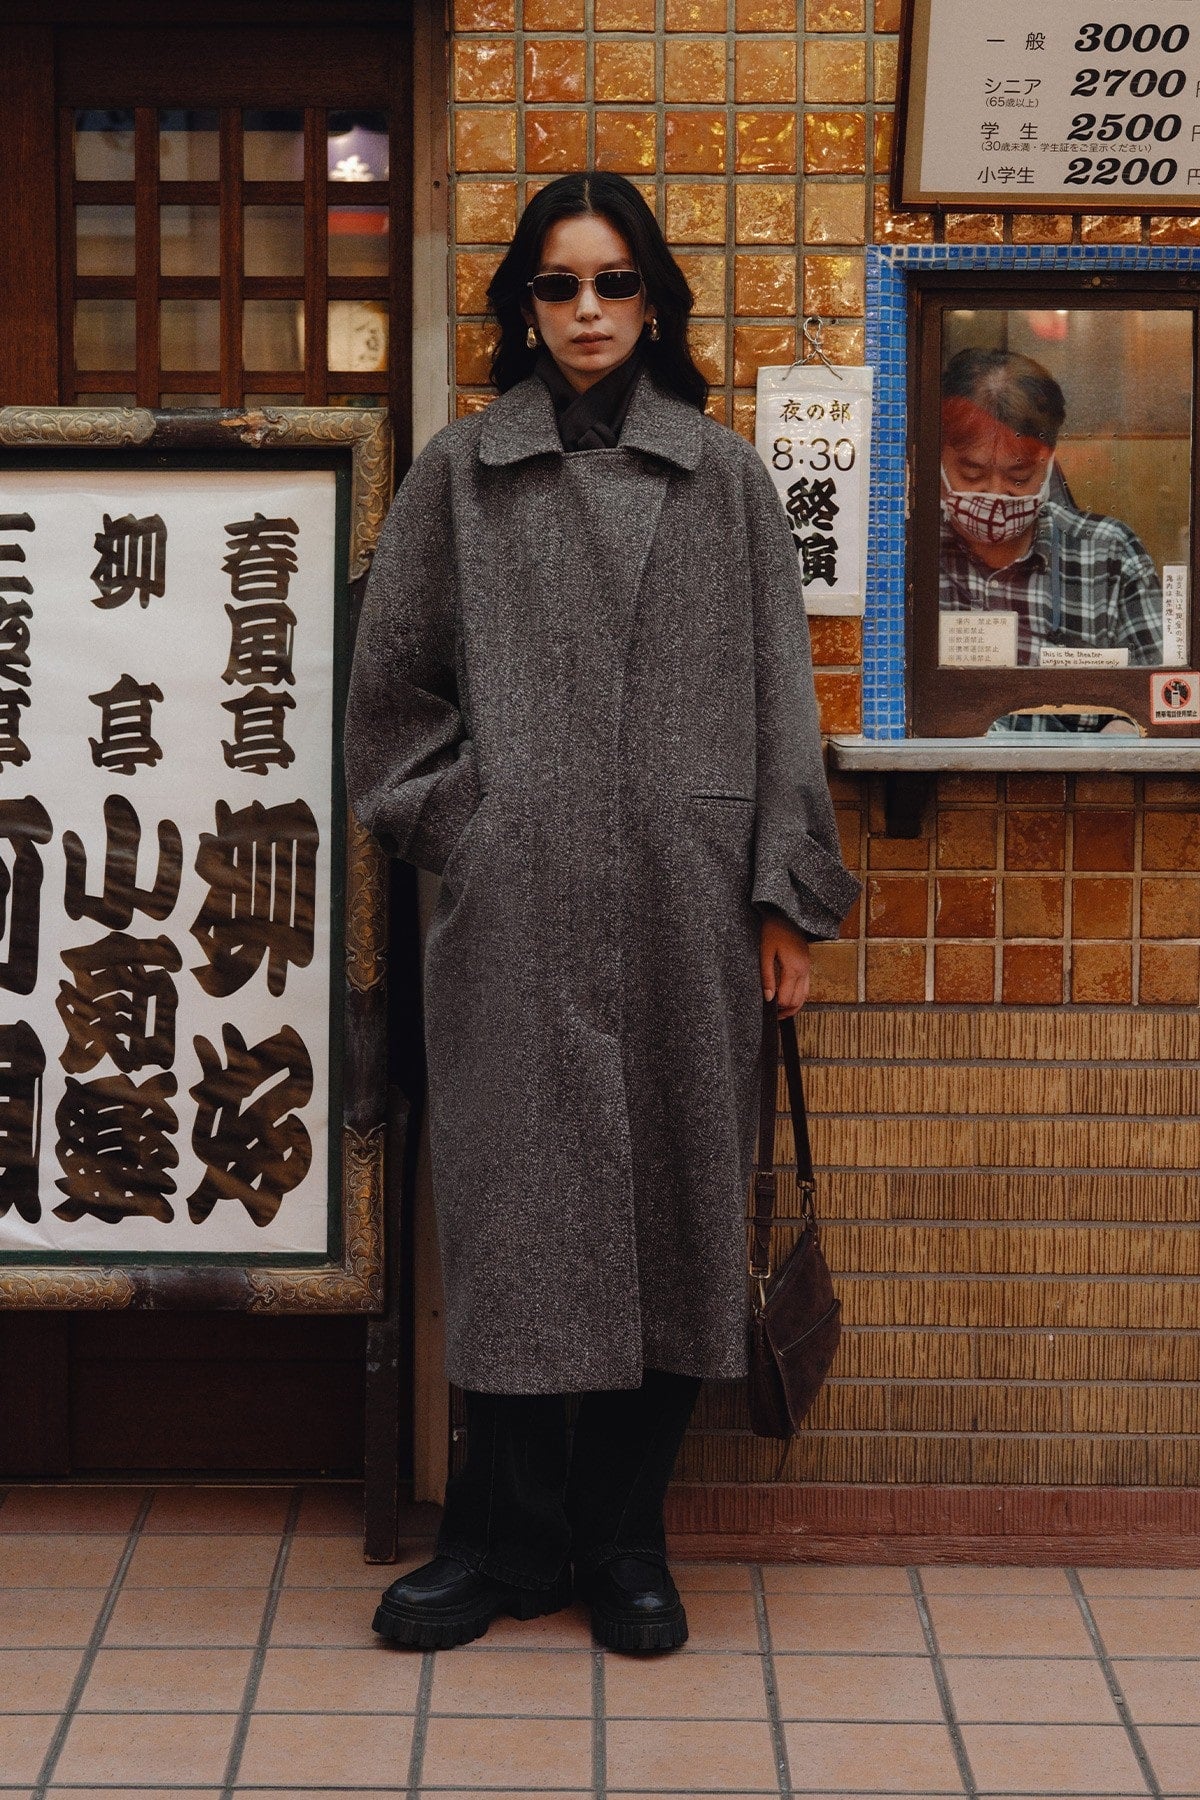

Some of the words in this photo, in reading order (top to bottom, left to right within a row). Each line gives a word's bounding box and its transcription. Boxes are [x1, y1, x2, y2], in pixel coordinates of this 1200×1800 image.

[1074, 23, 1190, 53] 3000
[984, 78, 1042, 95] シニア
[1070, 69, 1187, 98] 2700
[1067, 113, 1182, 142] 2500
[977, 167, 1034, 184] 小学生
[1063, 158, 1178, 186] 2200
[780, 400, 851, 424] 夜の部
[771, 437, 856, 472] 8:30
